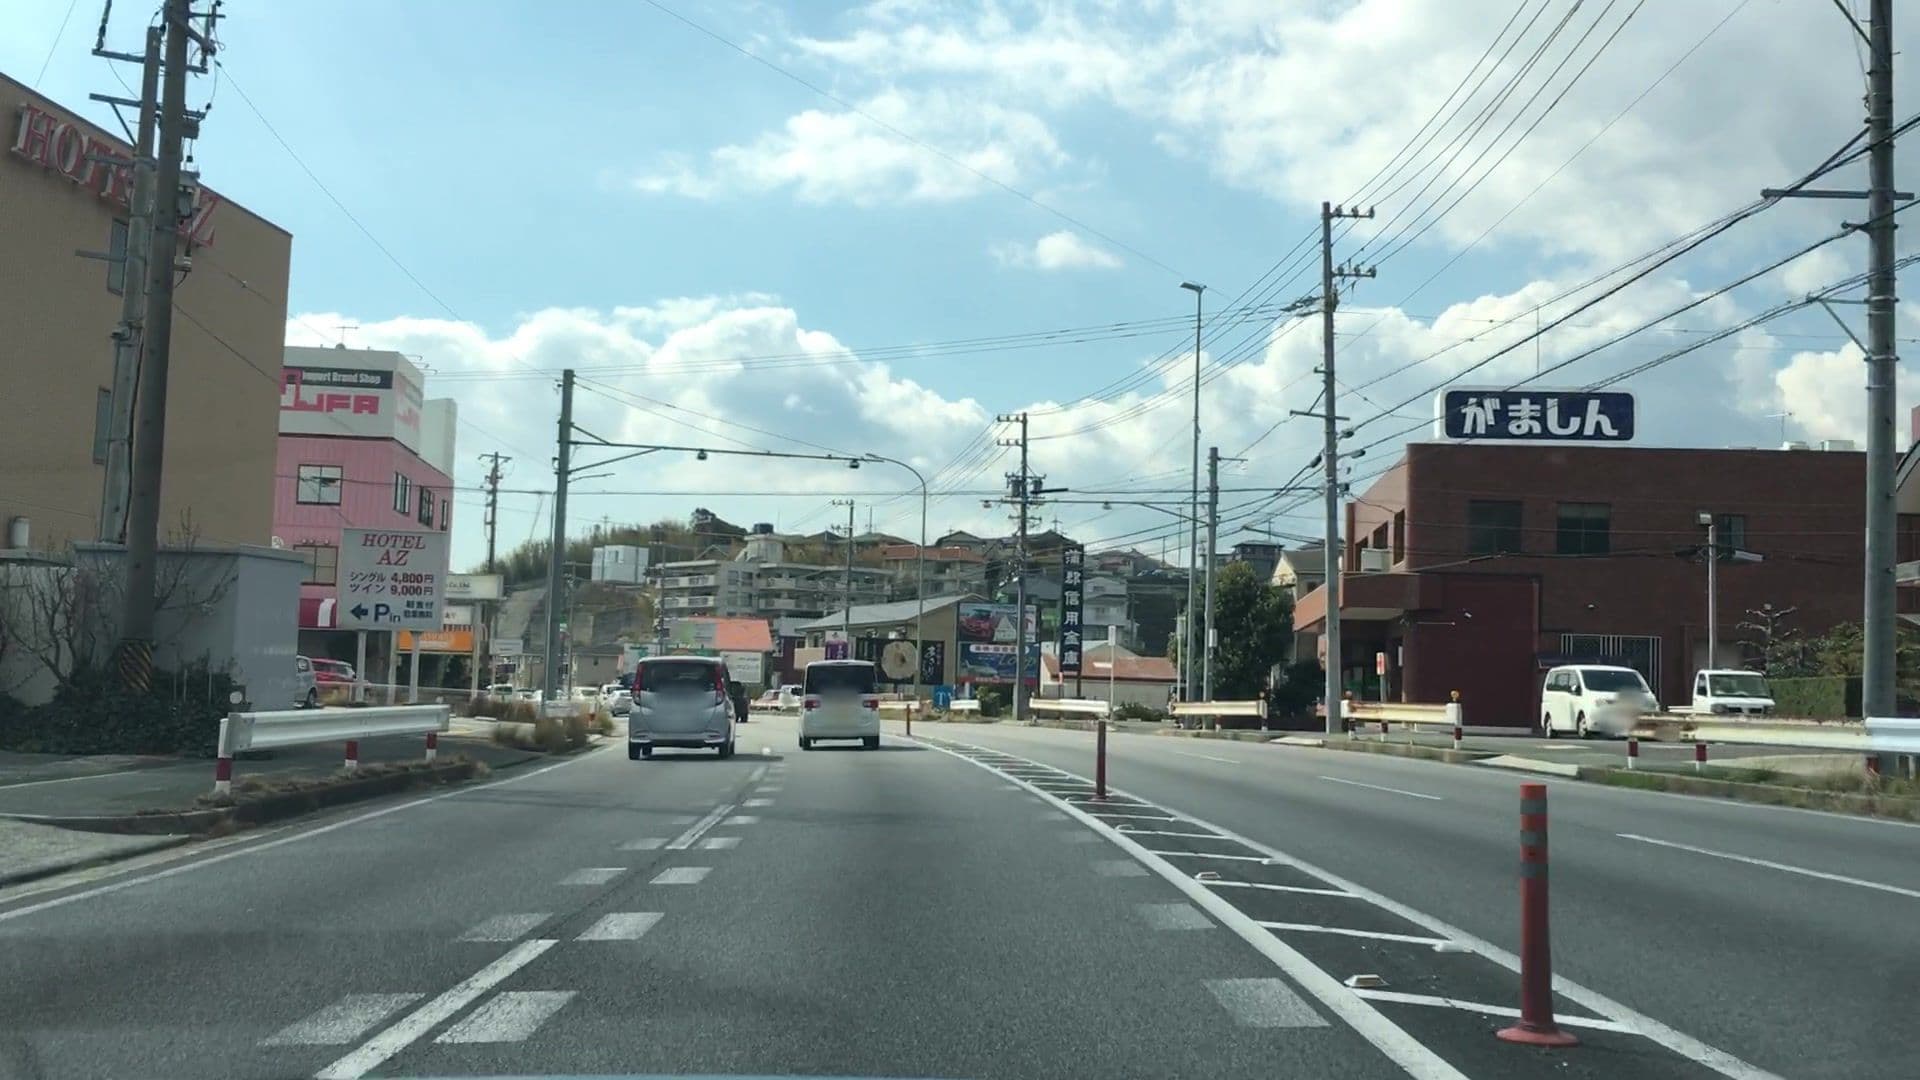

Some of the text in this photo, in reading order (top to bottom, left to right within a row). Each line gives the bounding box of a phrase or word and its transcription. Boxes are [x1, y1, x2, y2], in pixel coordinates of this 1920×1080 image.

[11, 103, 136, 208] HOTE
[1460, 398, 1619, 436] がましん
[361, 533, 427, 550] HOTEL
[376, 550, 411, 567] AZ
[350, 571, 434, 585] シングル 4,800円
[350, 583, 433, 597] ツイン 9,000円
